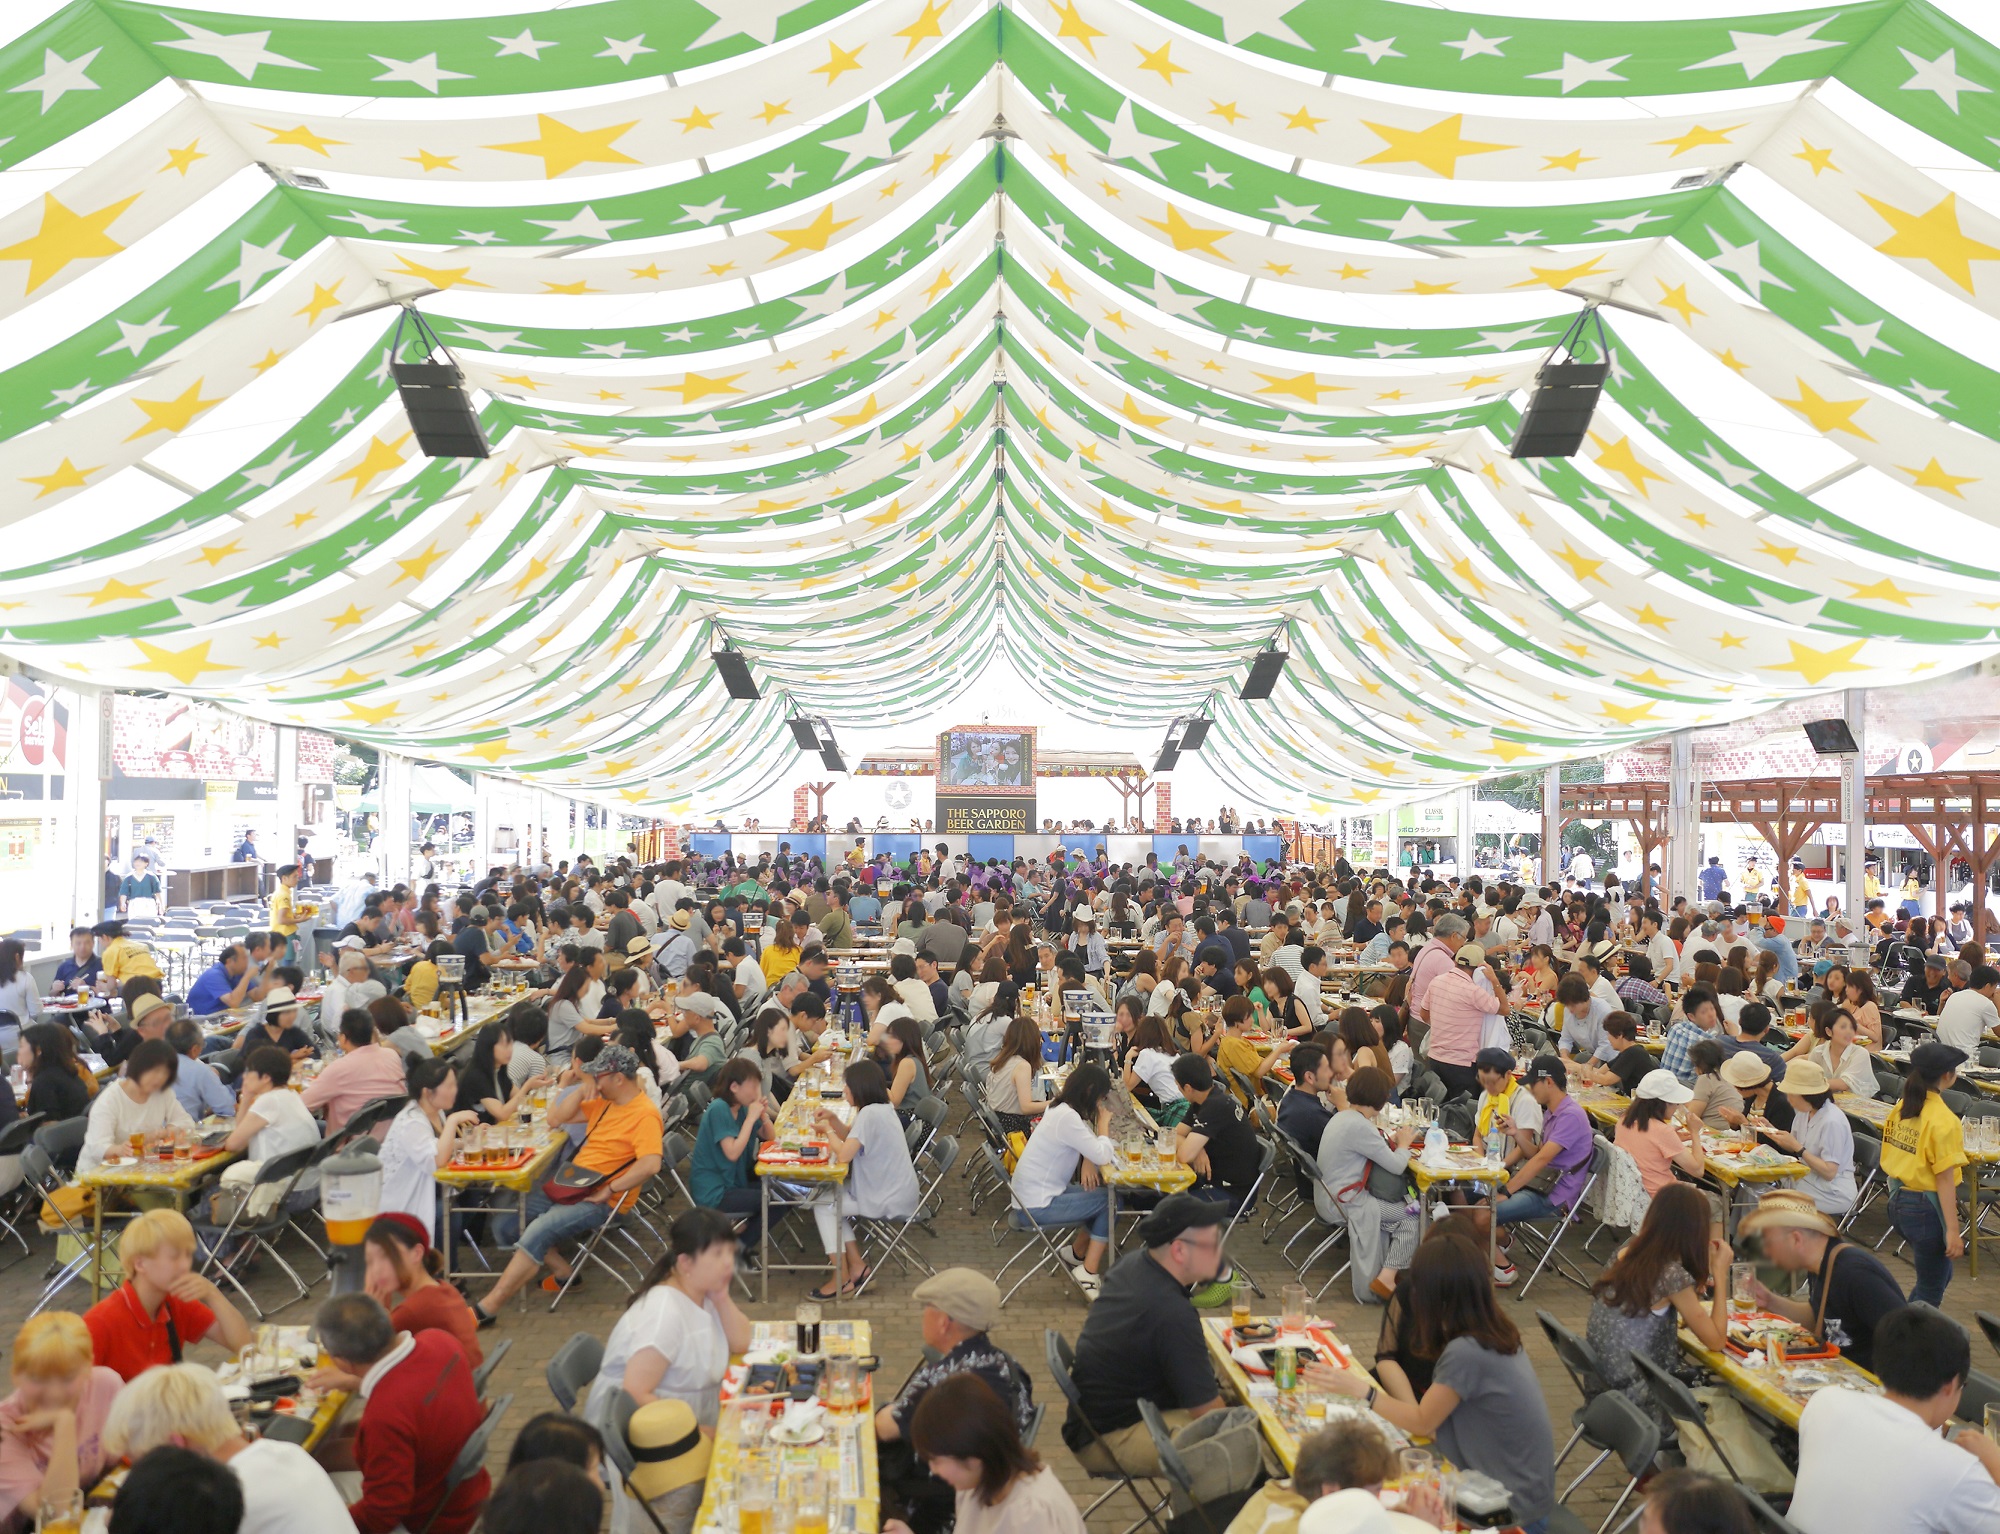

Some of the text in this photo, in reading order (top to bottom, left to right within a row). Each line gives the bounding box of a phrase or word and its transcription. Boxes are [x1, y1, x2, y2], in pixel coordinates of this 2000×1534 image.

[24, 715, 44, 735] Sel
[947, 808, 1026, 819] THE SAPPORO
[947, 819, 1026, 829] BEER GARDEN
